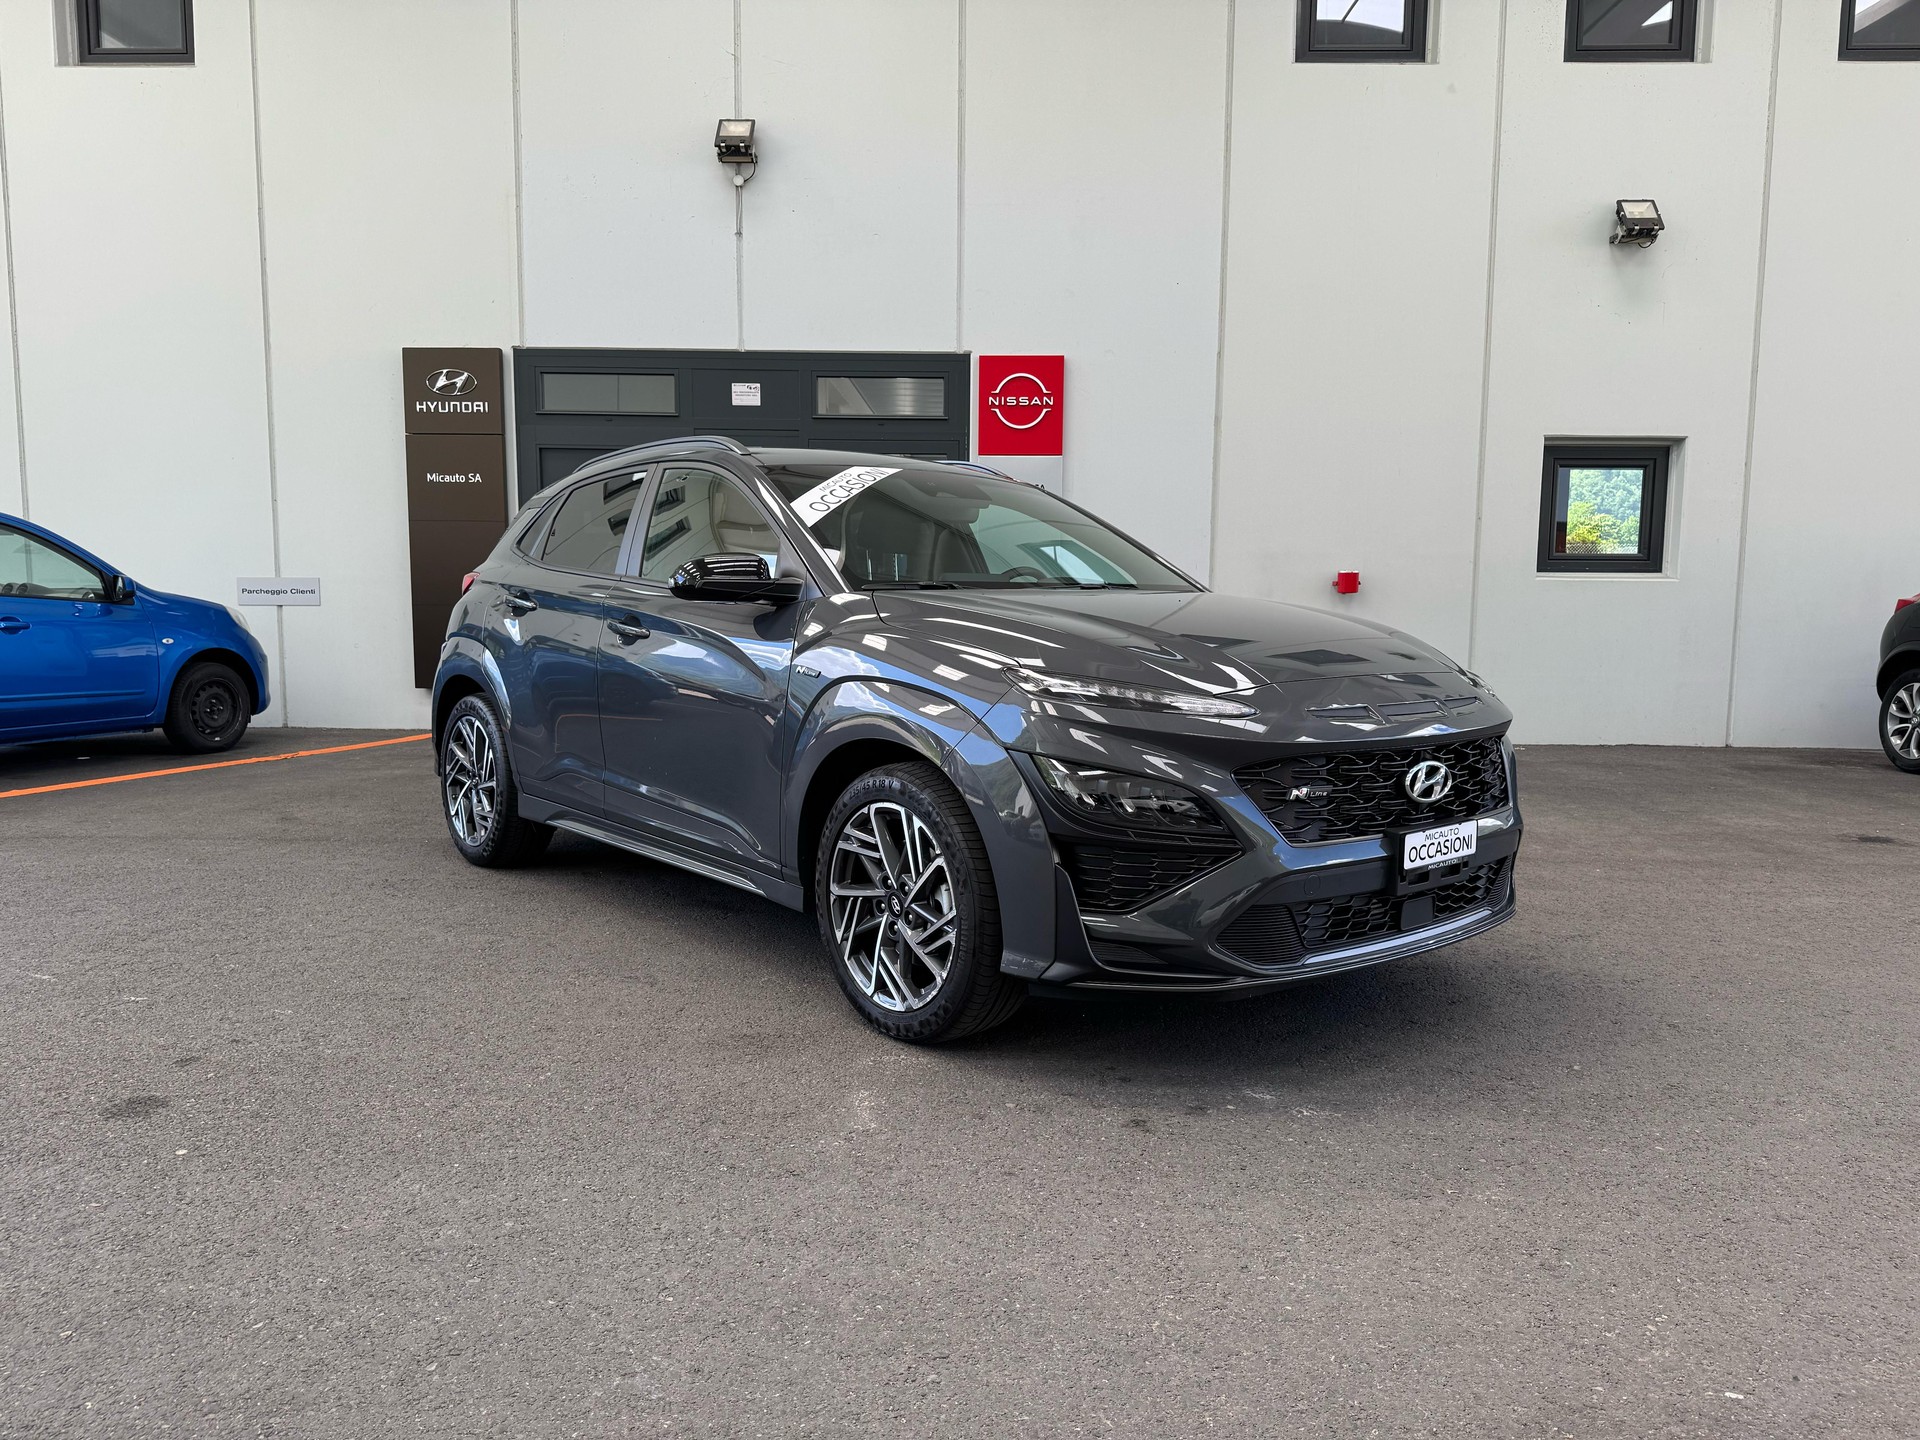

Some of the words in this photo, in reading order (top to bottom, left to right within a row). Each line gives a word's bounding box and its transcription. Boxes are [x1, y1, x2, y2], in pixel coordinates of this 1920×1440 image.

[416, 401, 489, 413] HYUNDAI
[988, 396, 1054, 406] NISSAN
[426, 472, 466, 483] Micauto
[468, 473, 482, 483] SA
[819, 472, 853, 492] MICAUTO
[809, 467, 890, 512] OCCASIONI
[241, 588, 288, 596] Parcheggio
[1424, 827, 1460, 841] MICAUTO
[1408, 834, 1473, 863] OCCASIONI
